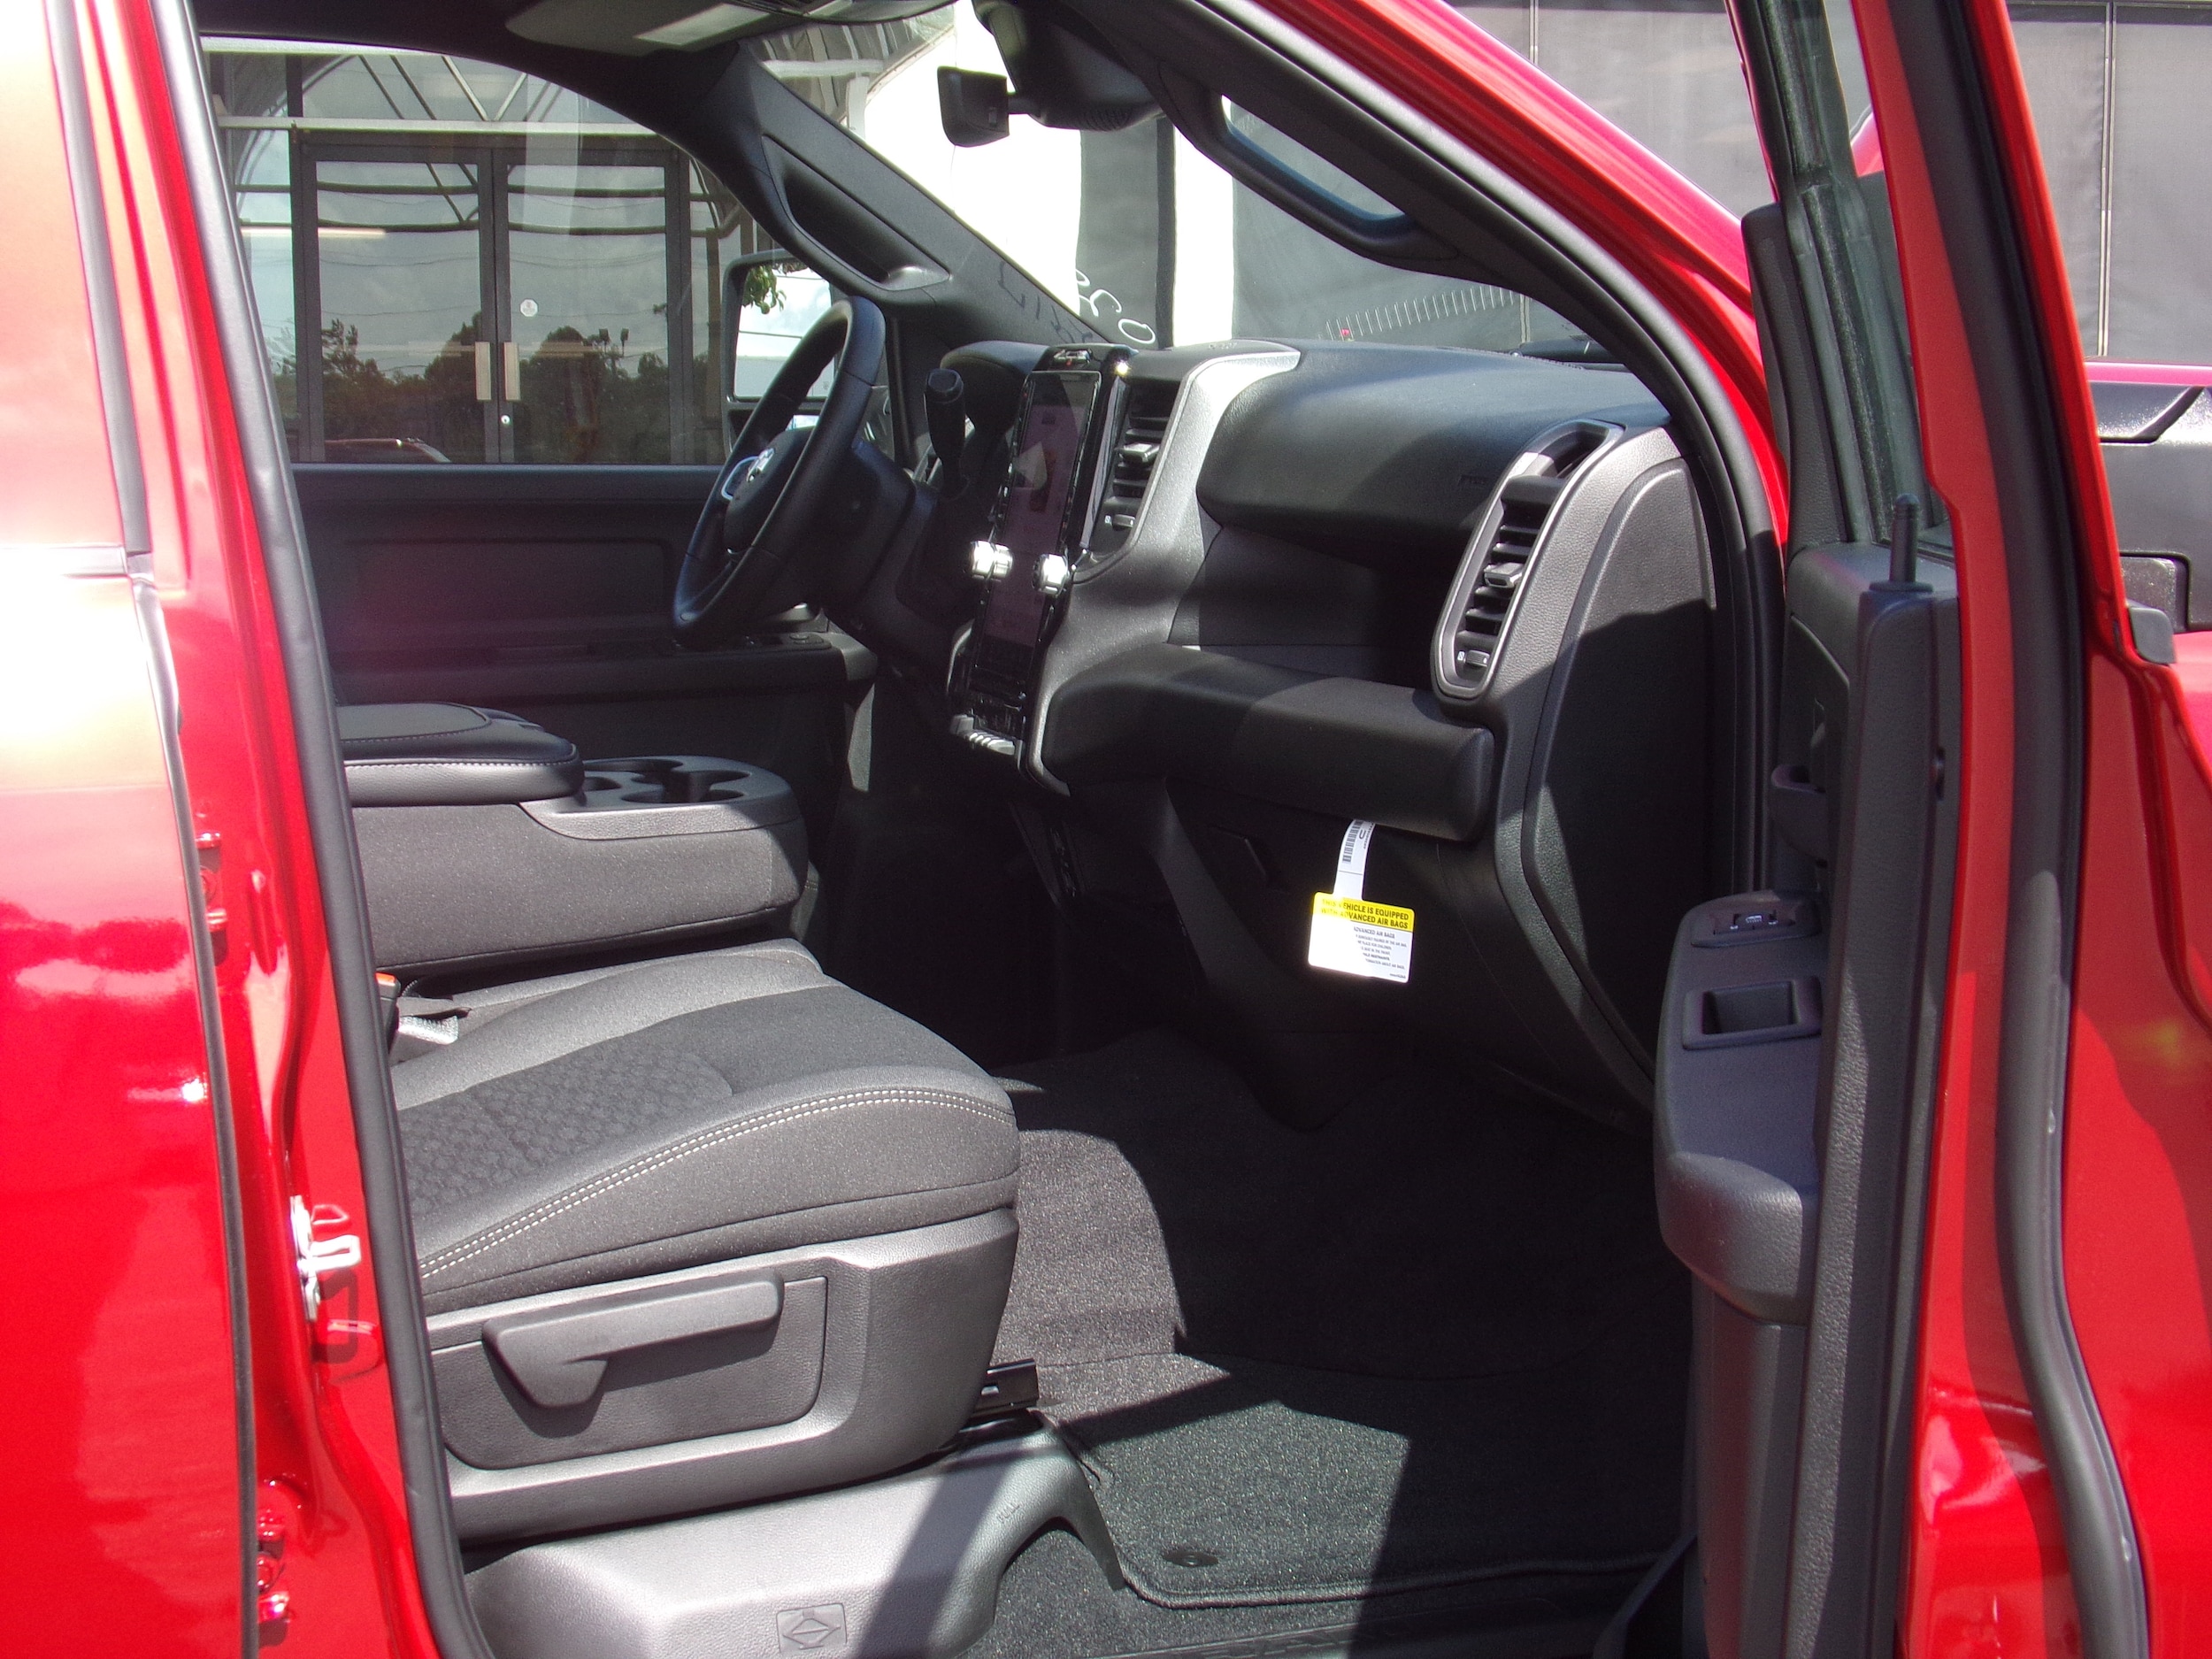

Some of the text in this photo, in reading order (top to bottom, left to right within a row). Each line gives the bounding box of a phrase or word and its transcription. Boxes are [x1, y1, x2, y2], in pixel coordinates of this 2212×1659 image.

[1338, 902, 1366, 914] VEHICLE
[1367, 905, 1374, 915] IS
[1375, 908, 1409, 921] EQUIPPED
[1340, 911, 1376, 924] ADVANCED
[1377, 916, 1389, 926] AIR
[1390, 918, 1409, 930] BAGS
